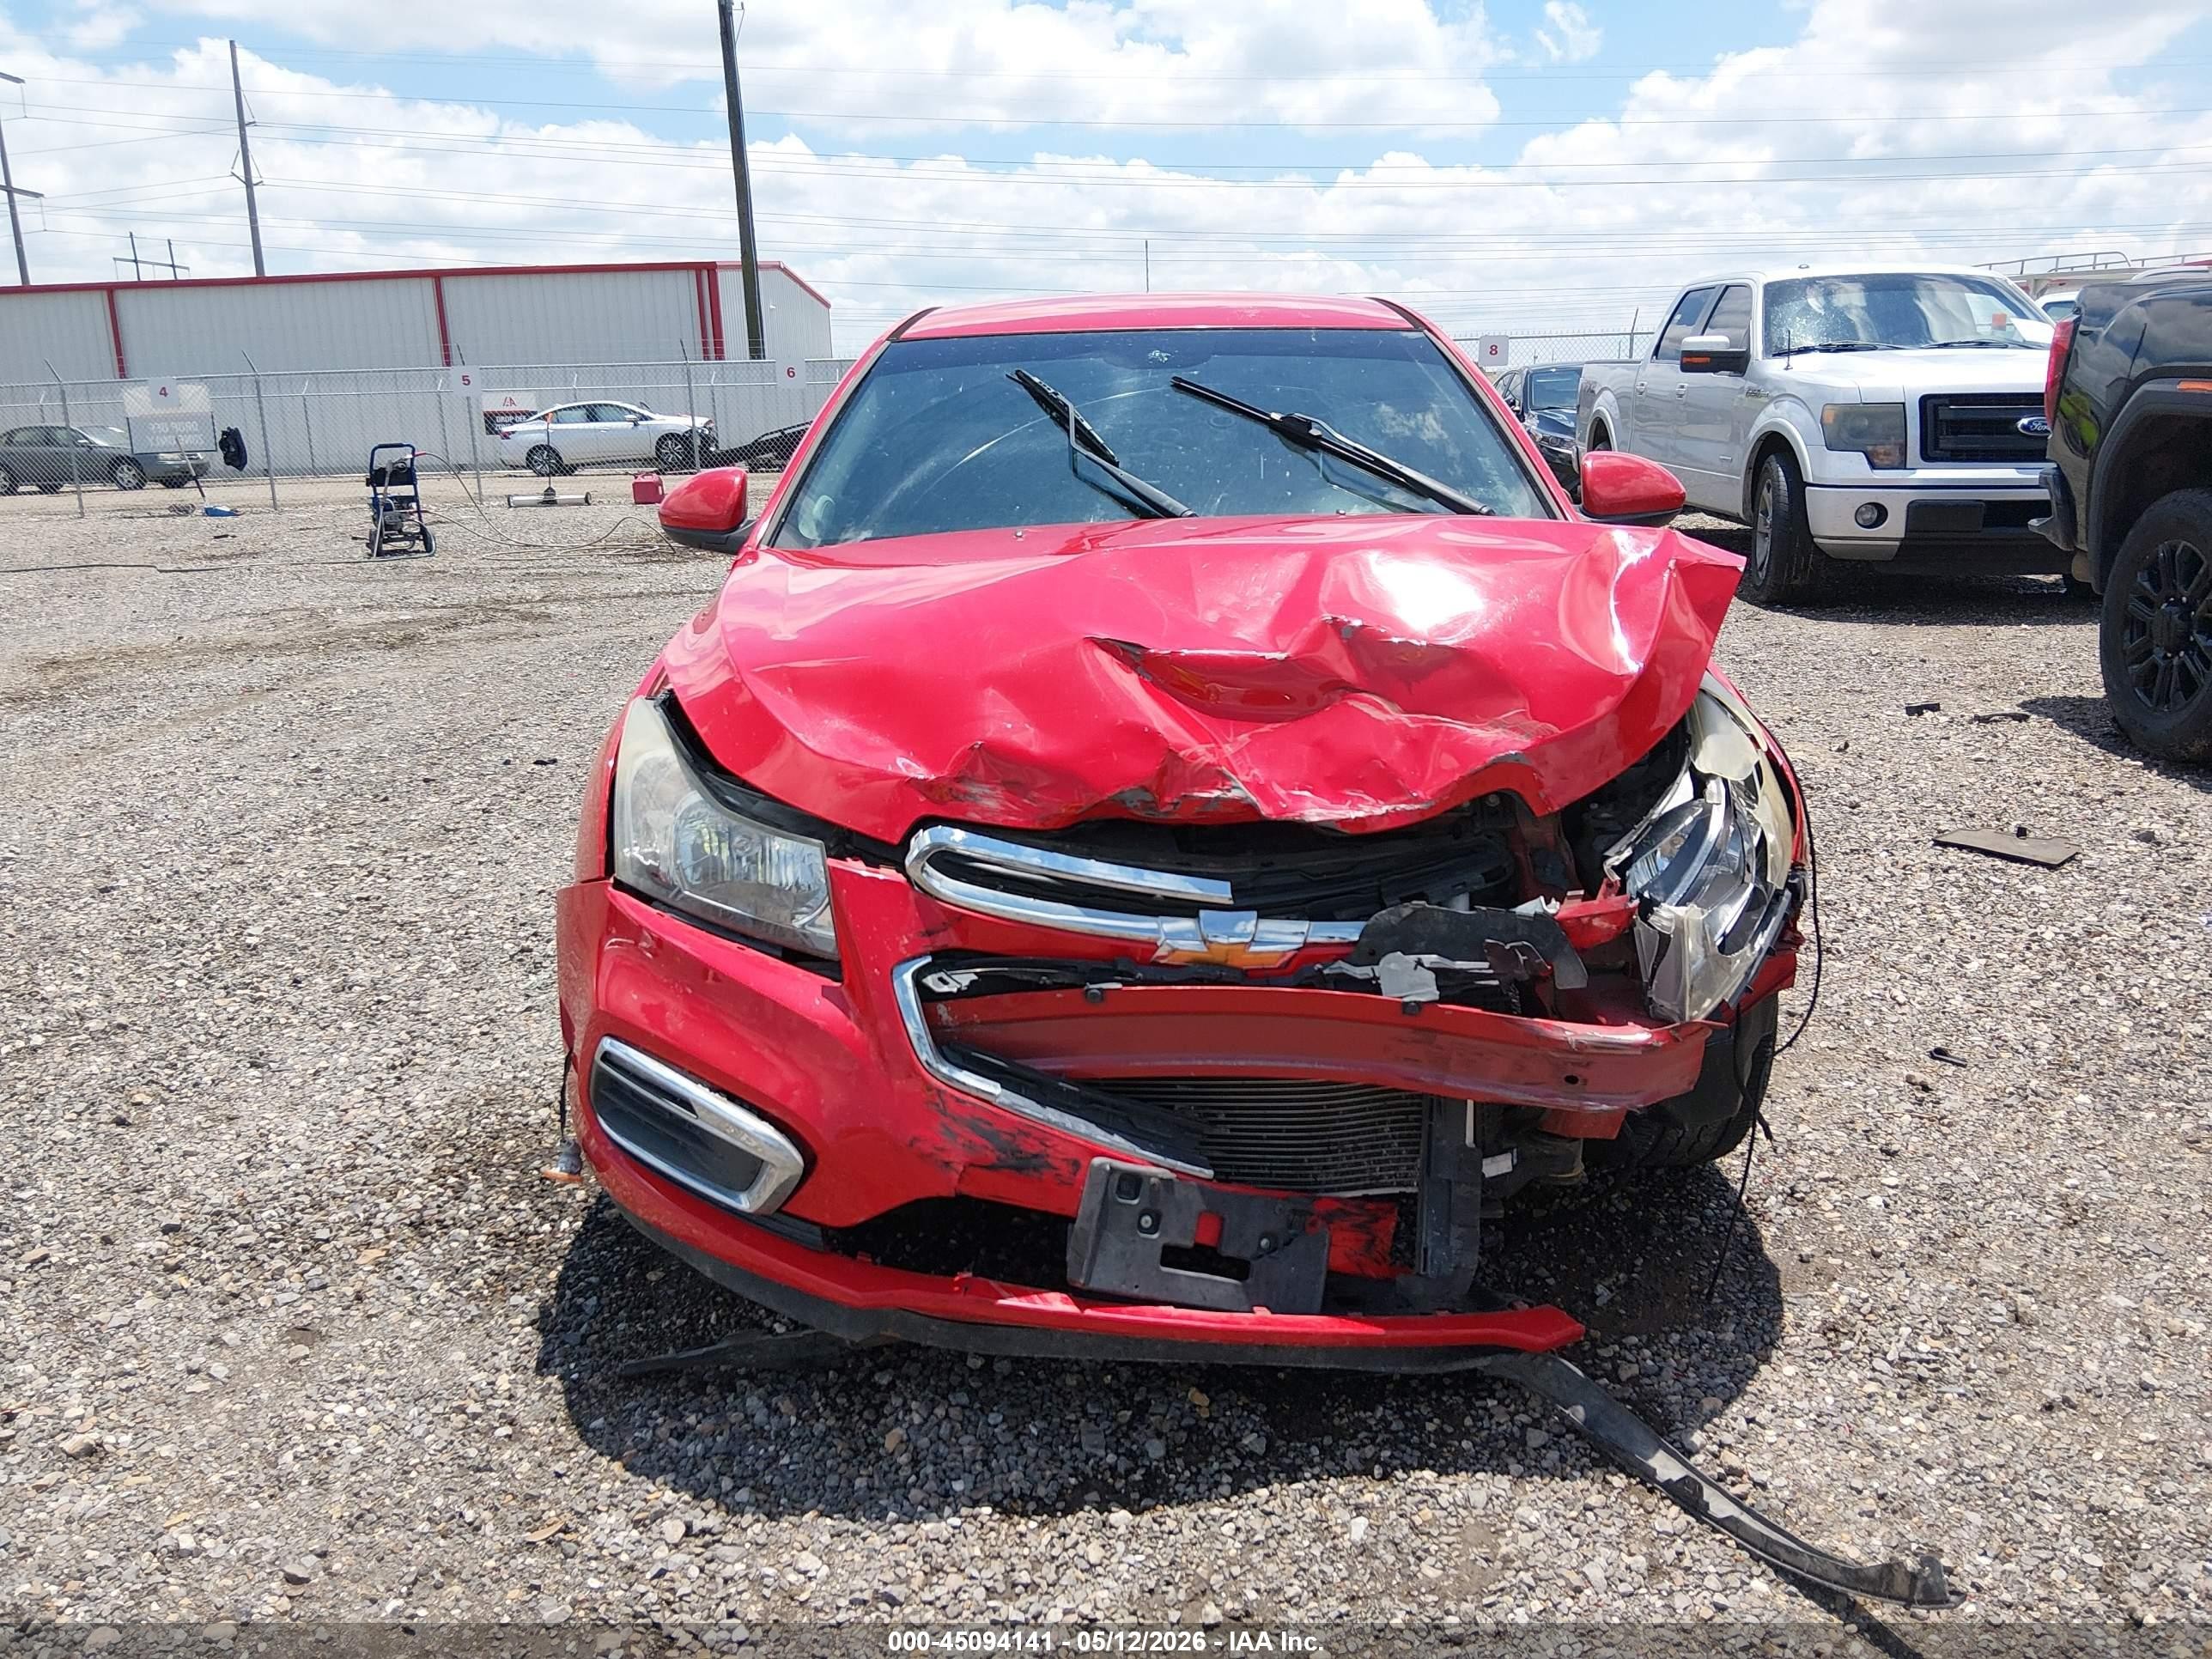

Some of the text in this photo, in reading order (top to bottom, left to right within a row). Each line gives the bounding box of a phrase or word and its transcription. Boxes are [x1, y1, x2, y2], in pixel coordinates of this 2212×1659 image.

[1489, 344, 1498, 356] 8
[787, 367, 796, 378] 6
[462, 375, 471, 386] 5
[159, 386, 168, 397] 4
[2030, 420, 2048, 431] For
